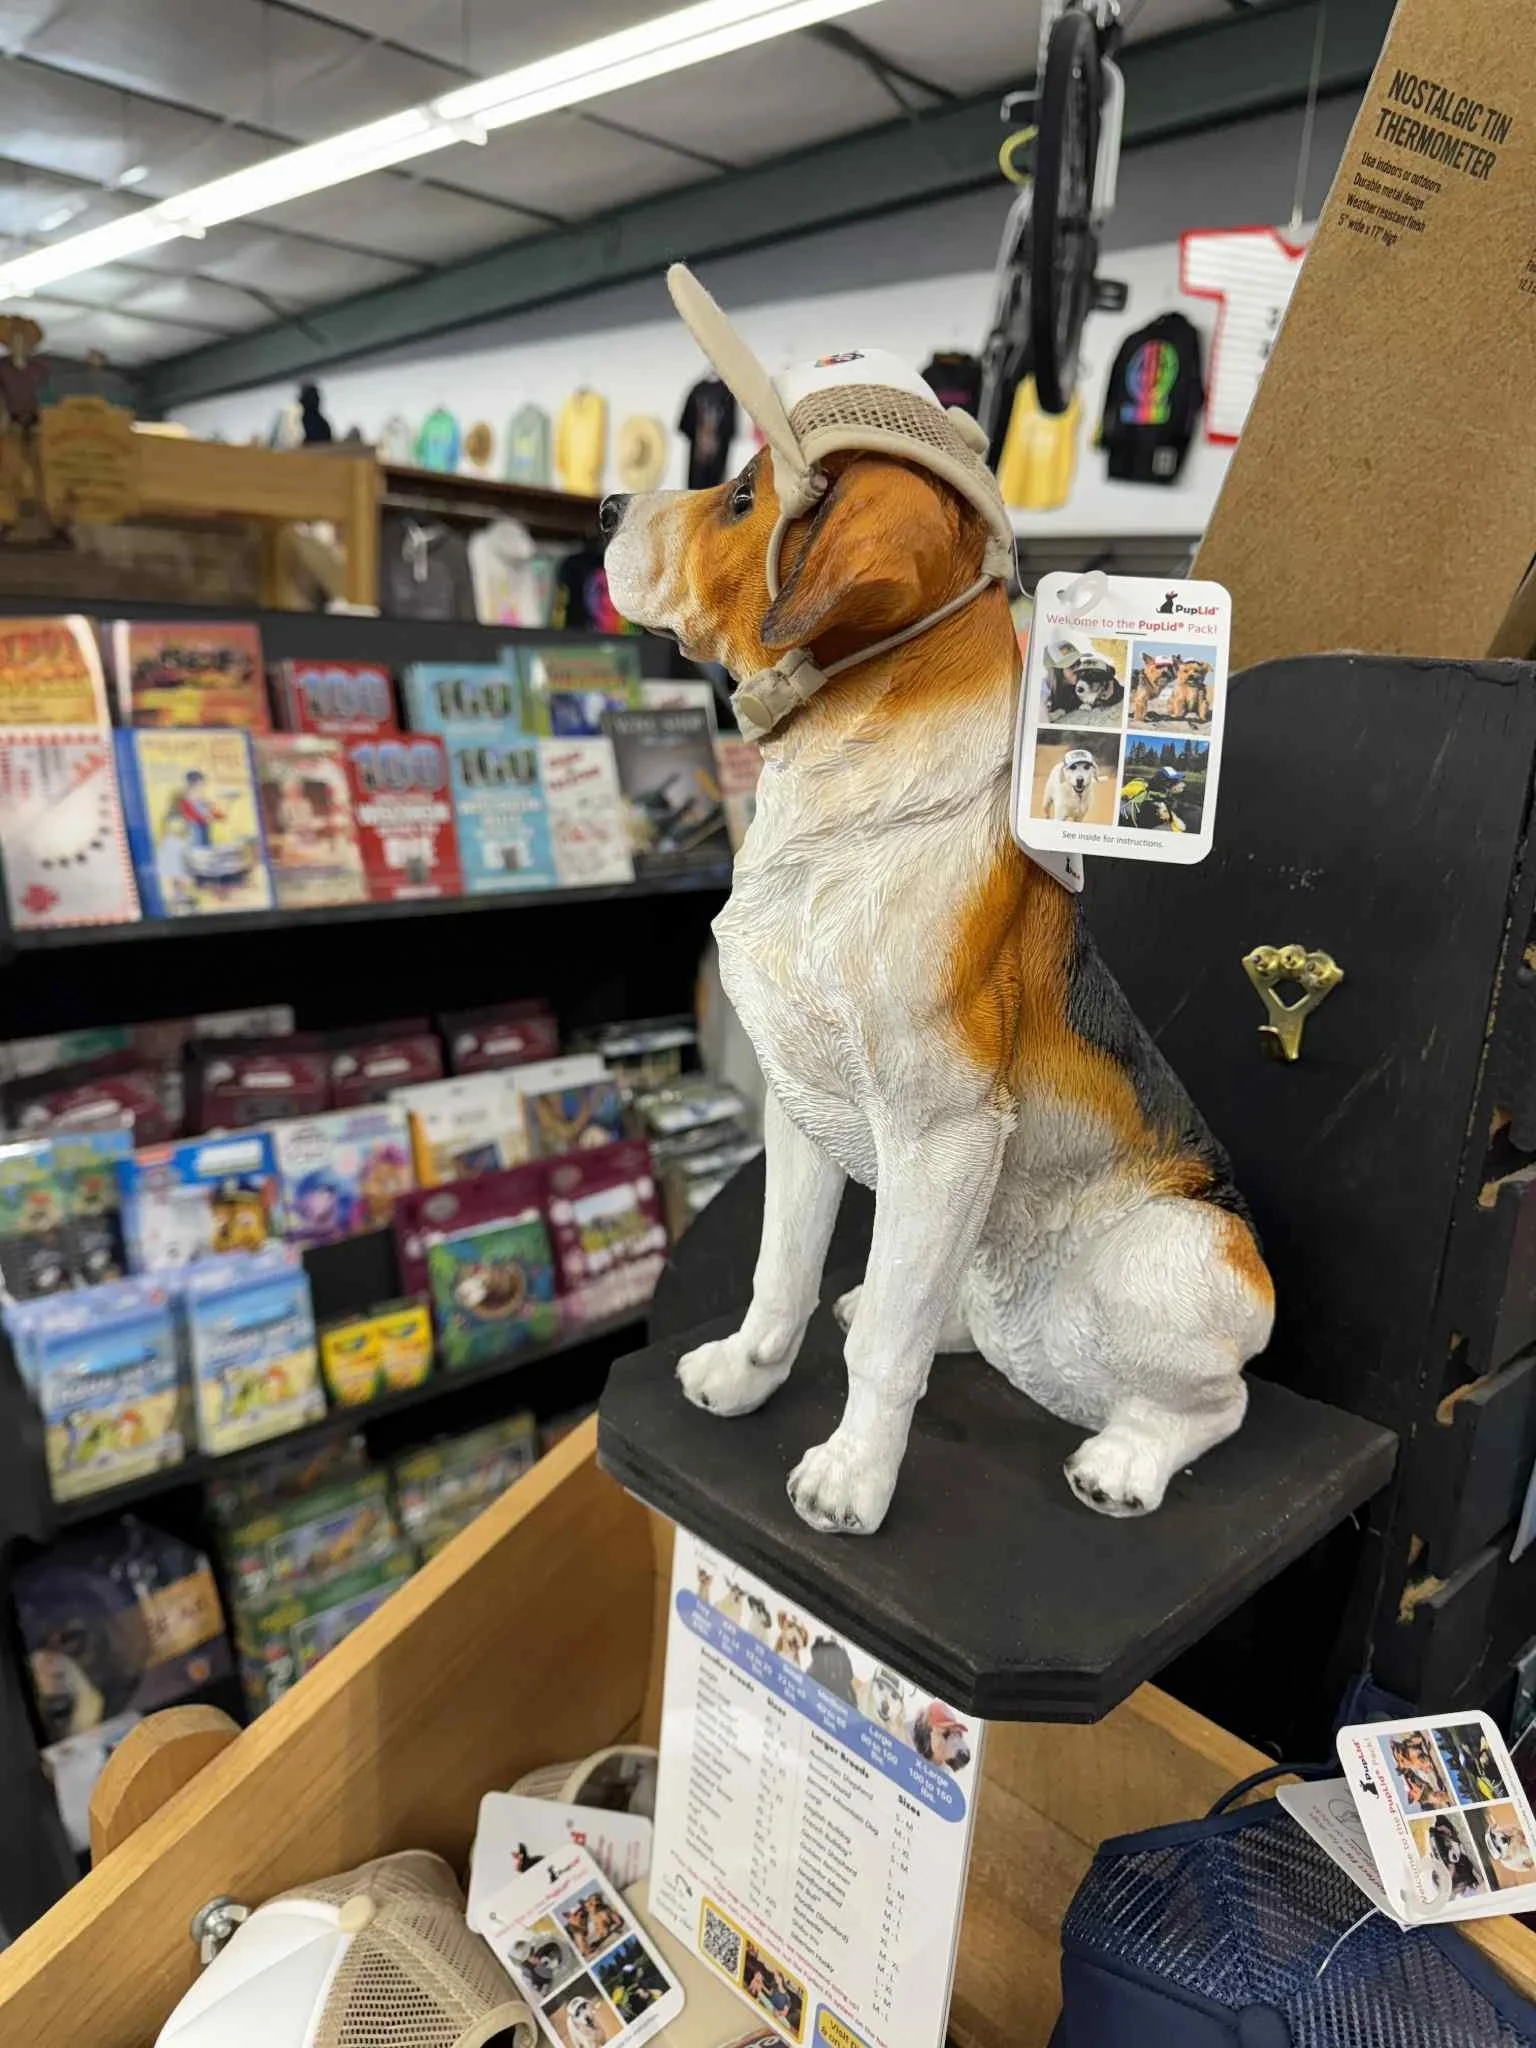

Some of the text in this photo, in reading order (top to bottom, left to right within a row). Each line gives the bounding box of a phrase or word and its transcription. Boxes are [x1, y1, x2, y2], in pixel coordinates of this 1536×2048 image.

[1387, 68, 1513, 145] NOSTALGIC TIN
[1375, 107, 1497, 181] THERMOMETER
[1353, 171, 1425, 211] Durable metal design
[1361, 151, 1441, 194] Use indoors or outdoors
[1346, 192, 1426, 233] Weather resistant finish
[1348, 218, 1365, 234] wide
[1046, 613, 1099, 629] Welcome
[1102, 617, 1114, 629] to
[1116, 618, 1136, 629] the
[1188, 623, 1217, 635] Pack!
[1175, 604, 1217, 617] PupLid
[1062, 830, 1077, 840] See
[1078, 831, 1101, 843] inside
[1103, 833, 1114, 843] for
[811, 1731, 869, 1778] Larger Breeds
[829, 2019, 850, 2042] Visit
